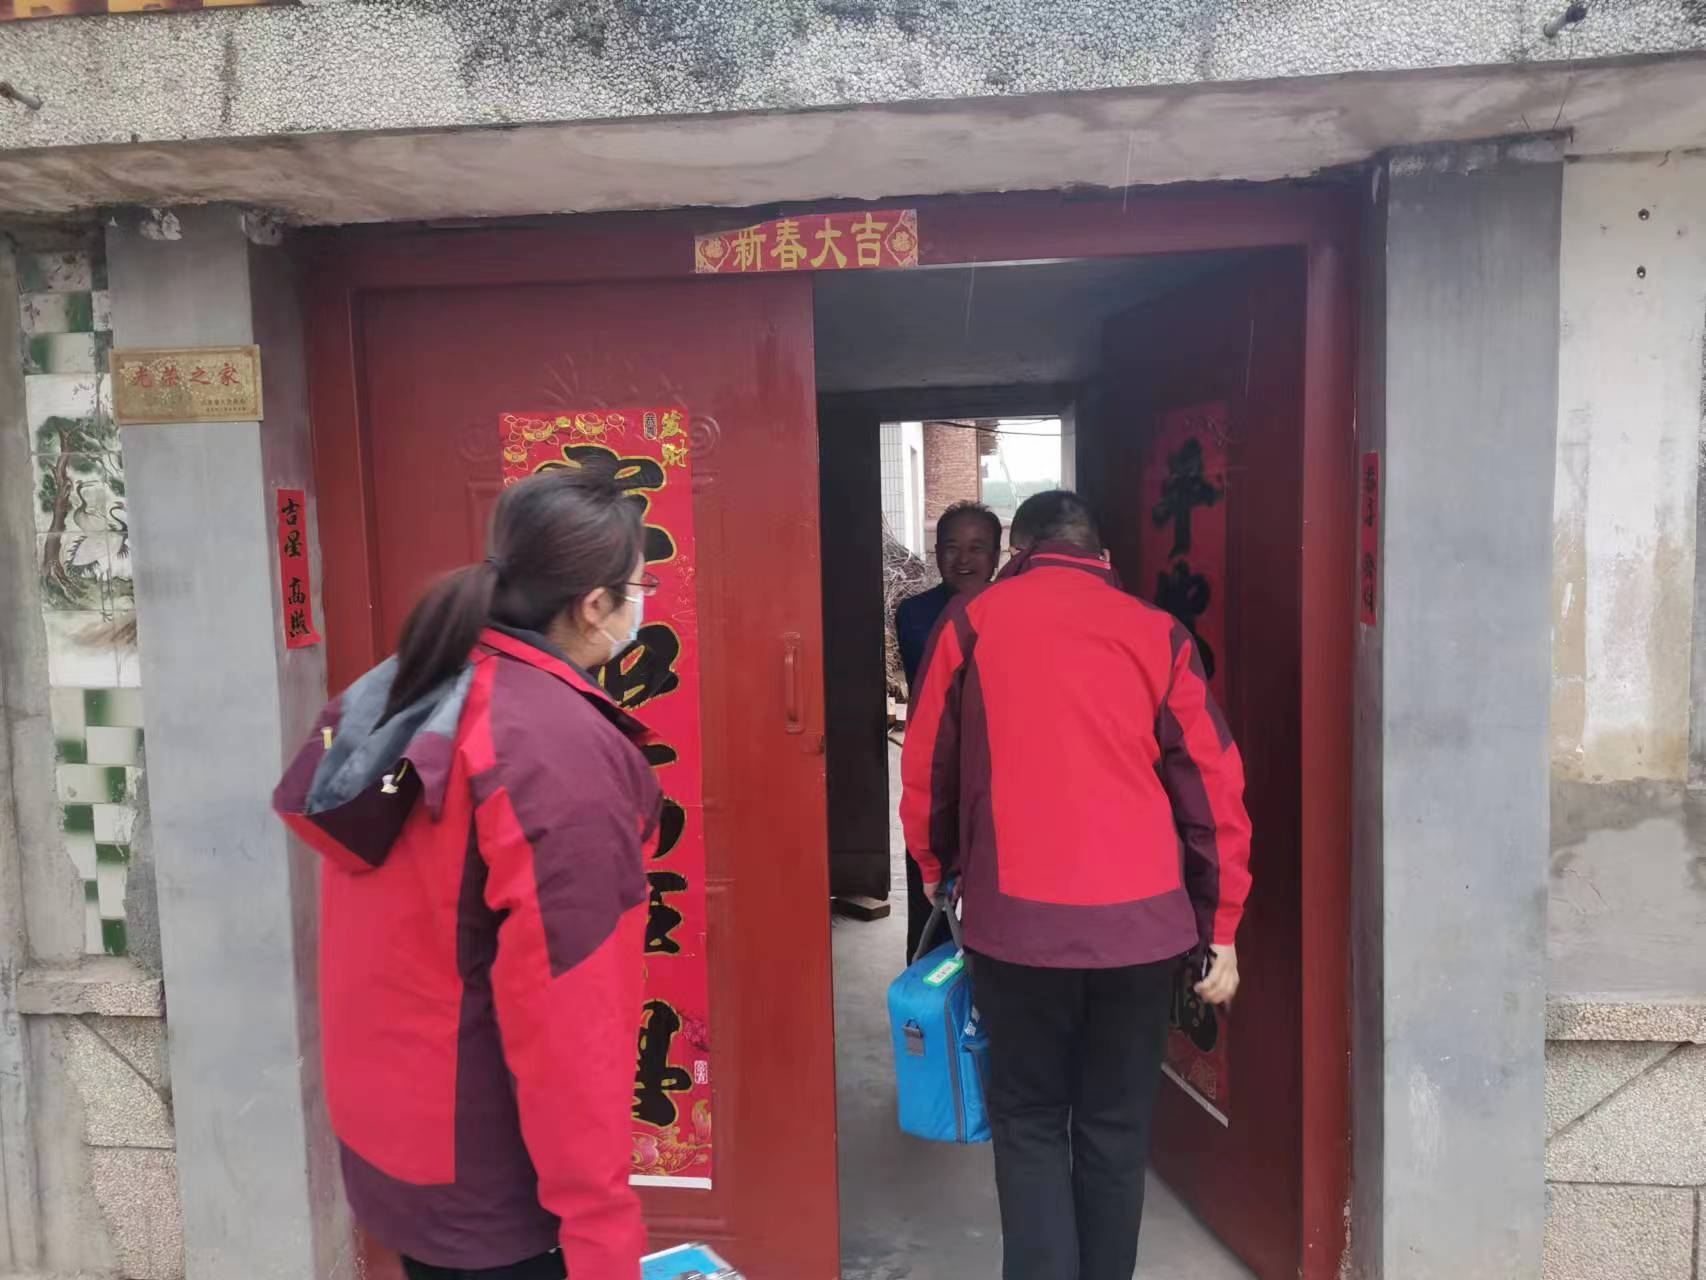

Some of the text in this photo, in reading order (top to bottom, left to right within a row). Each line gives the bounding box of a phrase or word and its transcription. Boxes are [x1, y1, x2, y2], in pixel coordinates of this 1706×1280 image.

[731, 211, 888, 272] 新春大吉
[133, 361, 240, 389] 光荣之家
[281, 498, 311, 638] 吉星高照
